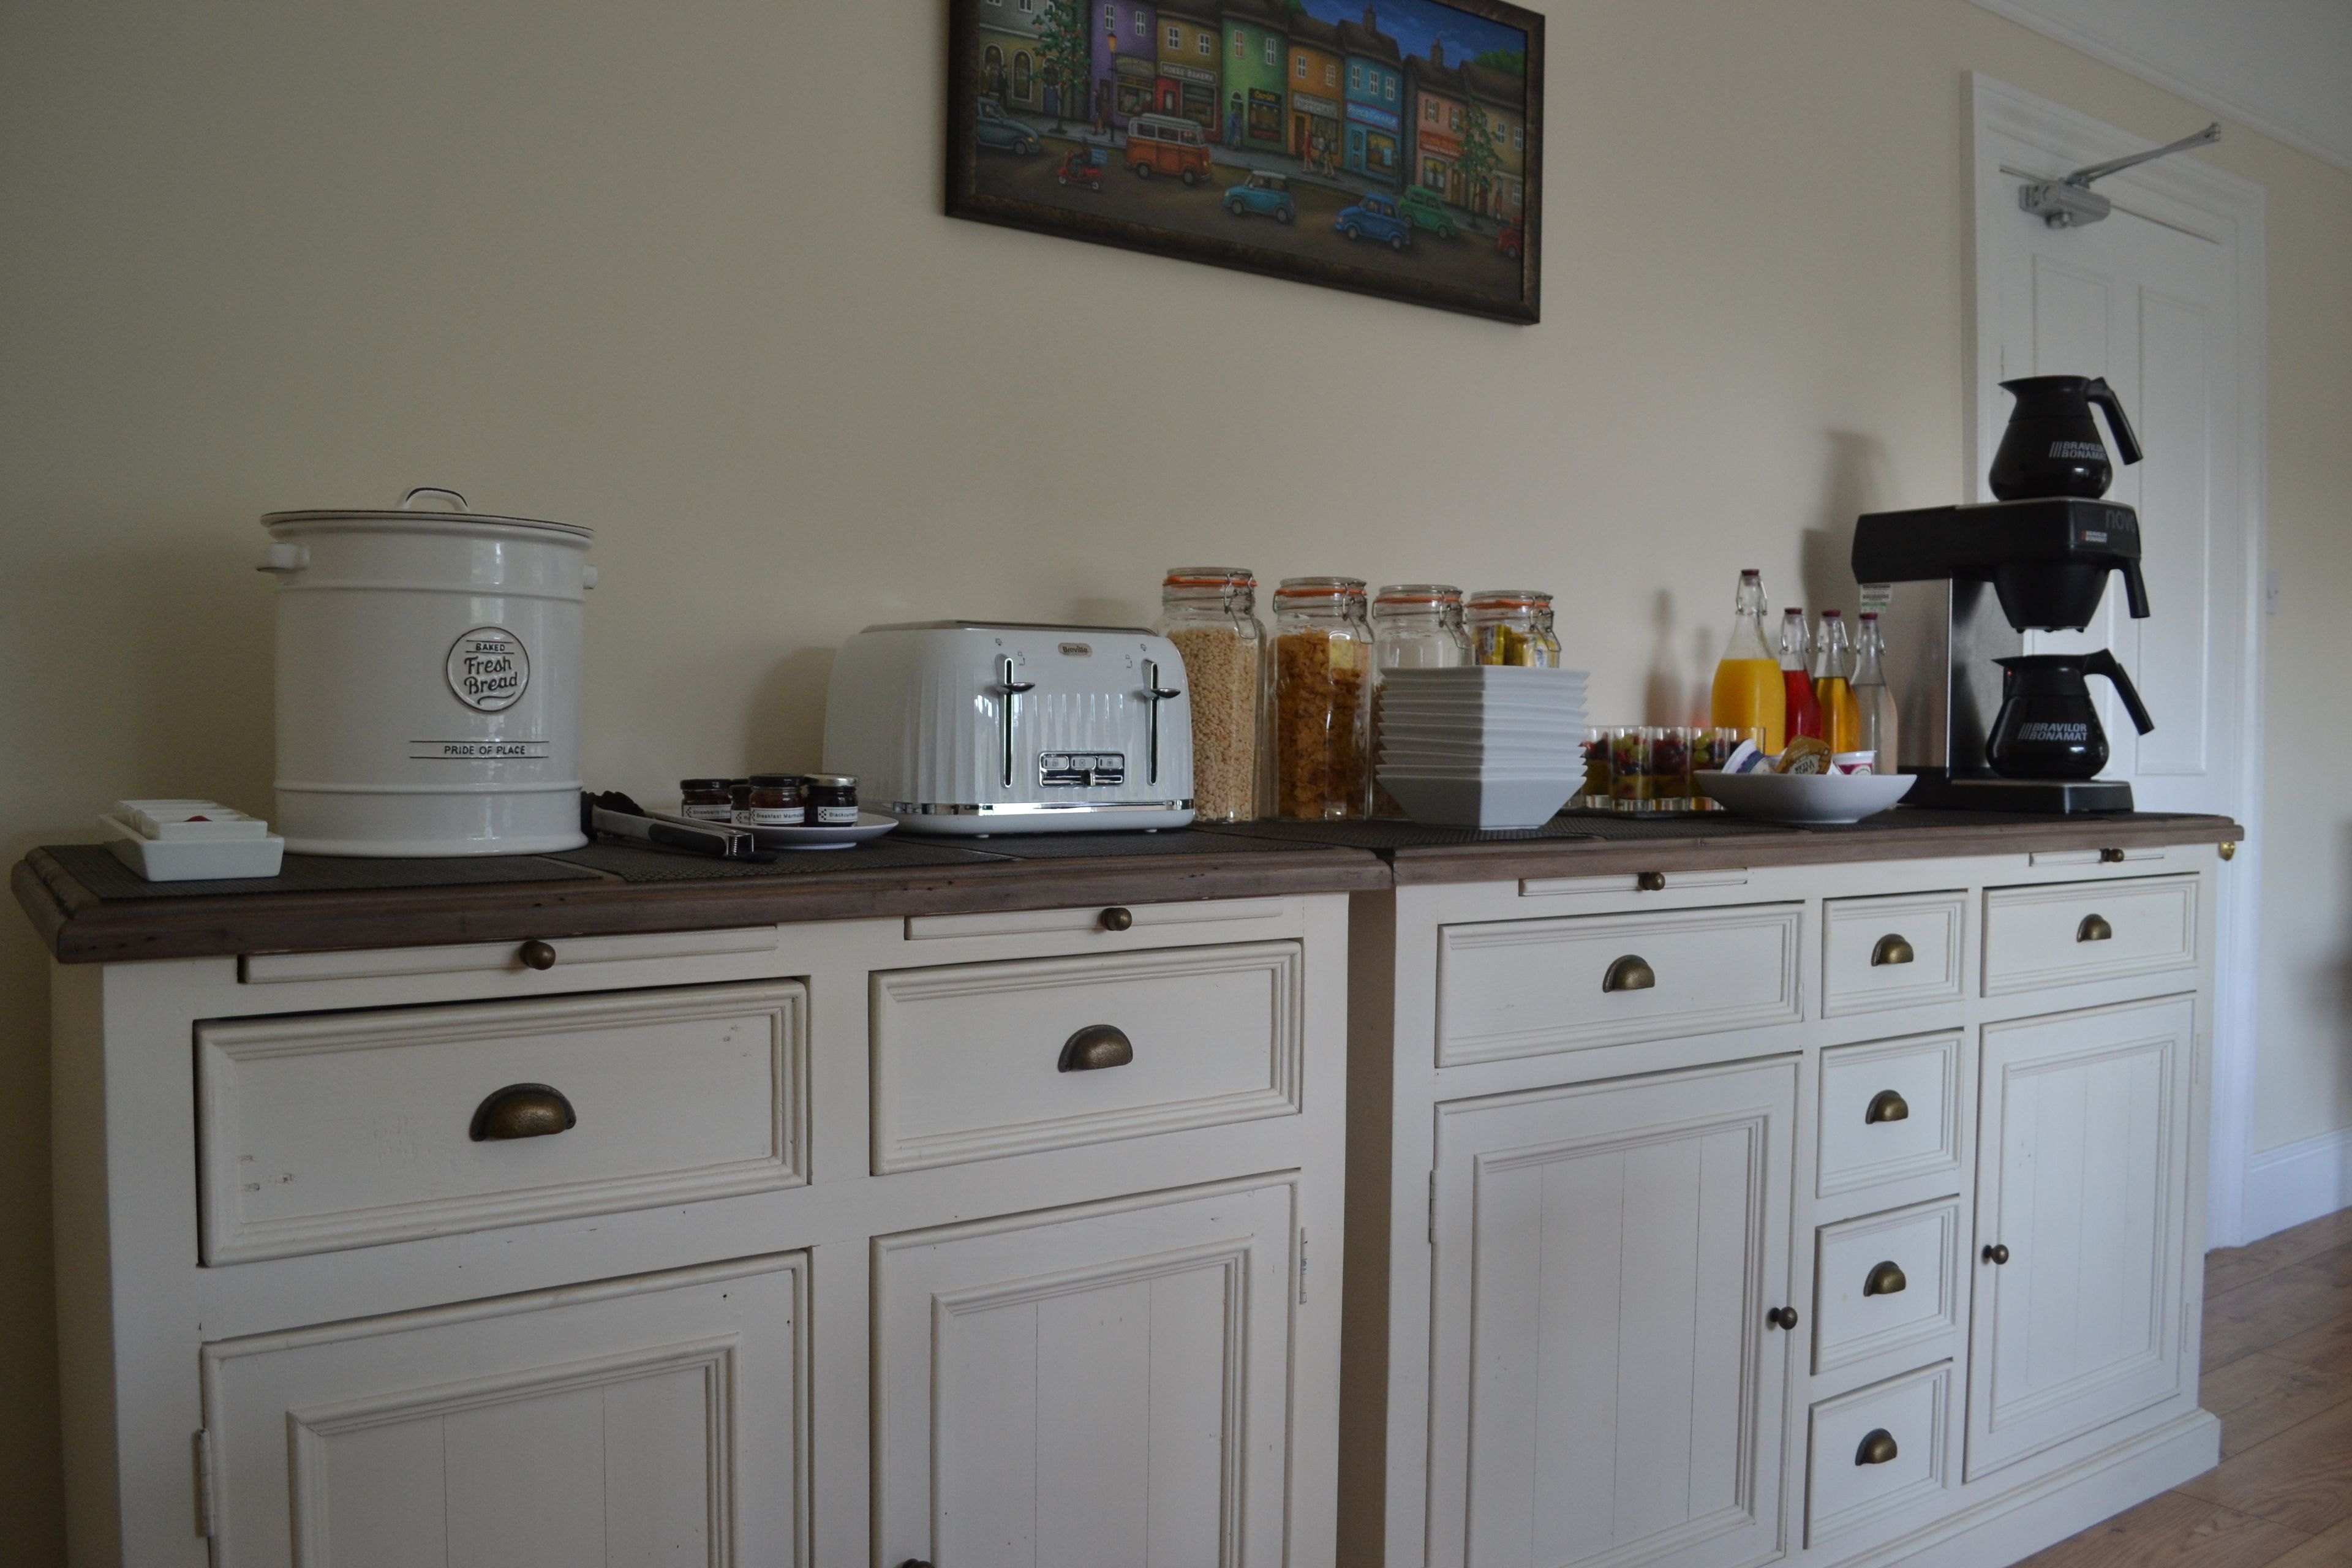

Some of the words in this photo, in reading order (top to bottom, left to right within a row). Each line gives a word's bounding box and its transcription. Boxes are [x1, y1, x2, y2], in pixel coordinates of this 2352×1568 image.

[464, 655, 511, 674] Fresh
[464, 672, 518, 695] Bread
[2032, 723, 2087, 732] BRAVILOR
[2029, 731, 2088, 741] BONAMAT
[444, 745, 475, 755] PRIDE
[479, 745, 492, 755] OF
[496, 745, 526, 755] PLACE
